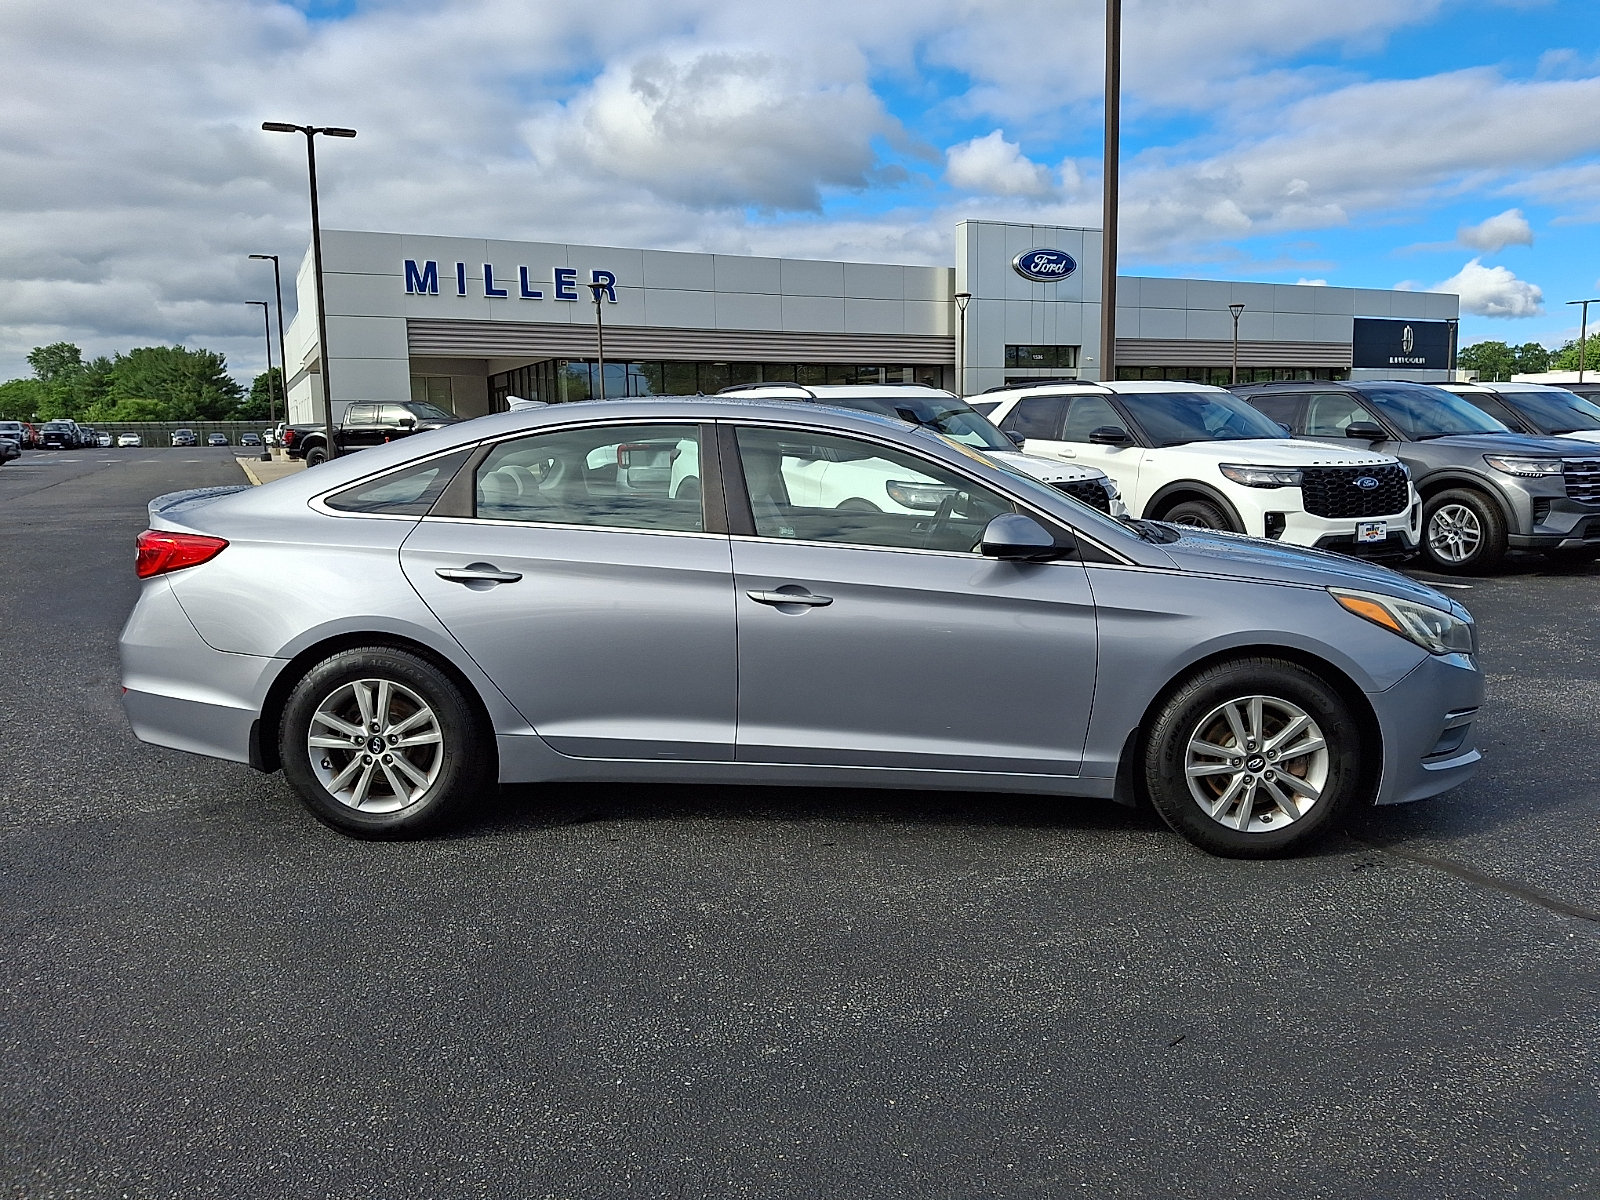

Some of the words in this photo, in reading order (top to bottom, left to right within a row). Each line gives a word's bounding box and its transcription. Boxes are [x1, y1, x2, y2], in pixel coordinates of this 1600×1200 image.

[1031, 254, 1066, 273] Ford
[403, 259, 618, 303] MILLER
[1389, 356, 1426, 364] LINCOLN
